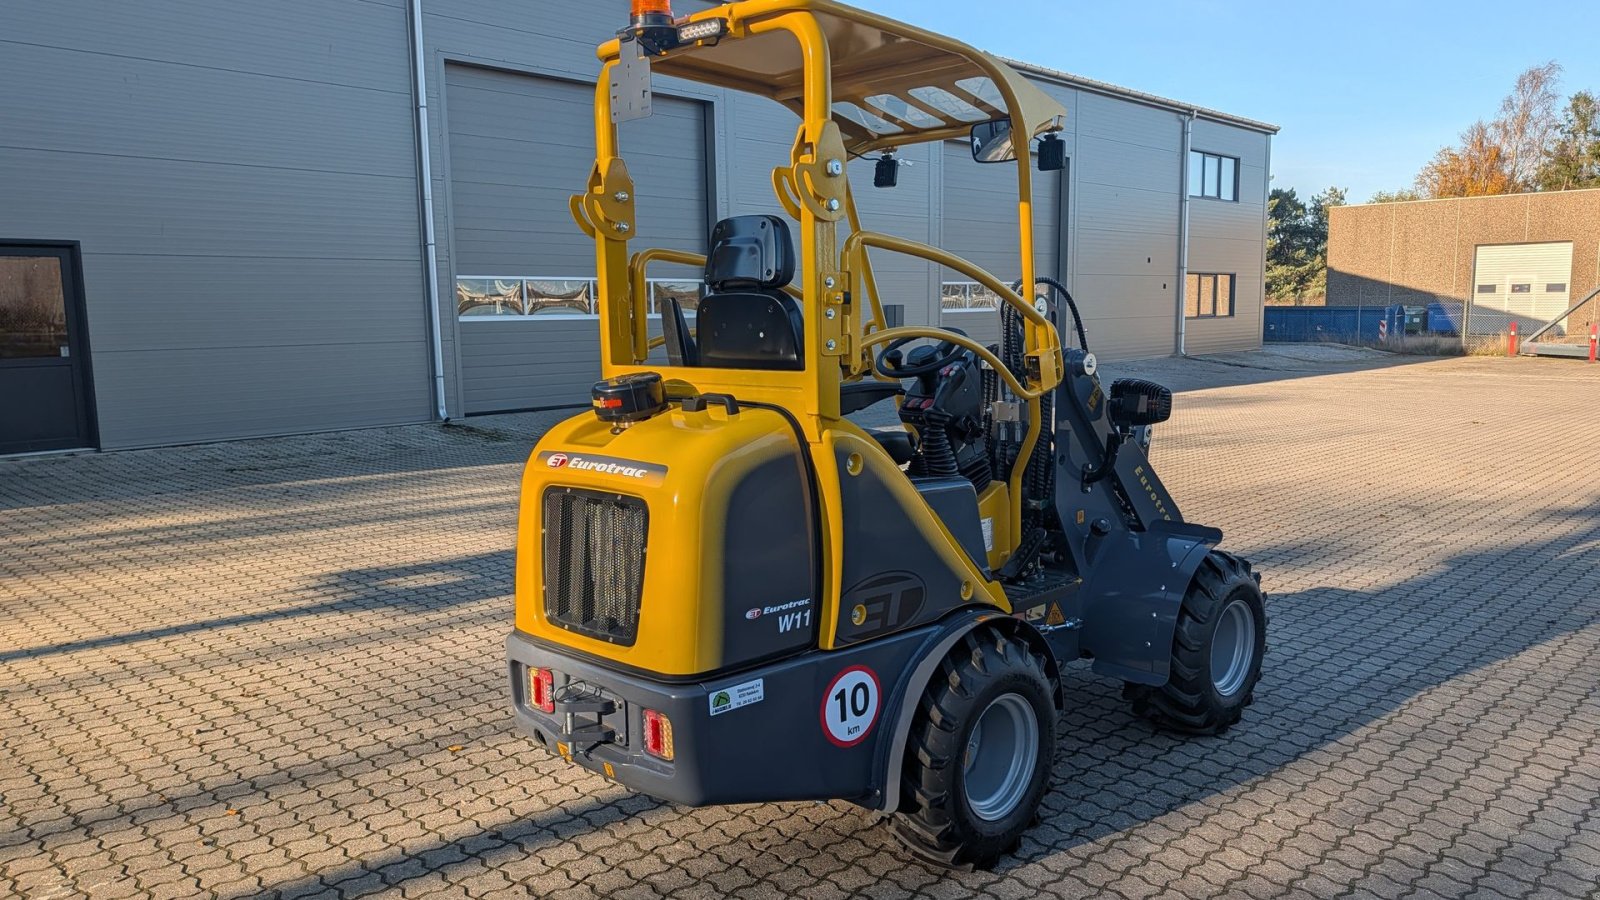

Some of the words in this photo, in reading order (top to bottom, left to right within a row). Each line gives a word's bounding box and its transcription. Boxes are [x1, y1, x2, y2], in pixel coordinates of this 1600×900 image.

[567, 457, 648, 478] Eurotrac
[1134, 465, 1171, 520] Eurotra
[763, 598, 811, 615] Eurotrac
[778, 609, 811, 633] W11
[834, 681, 870, 723] 10
[847, 725, 860, 736] km
